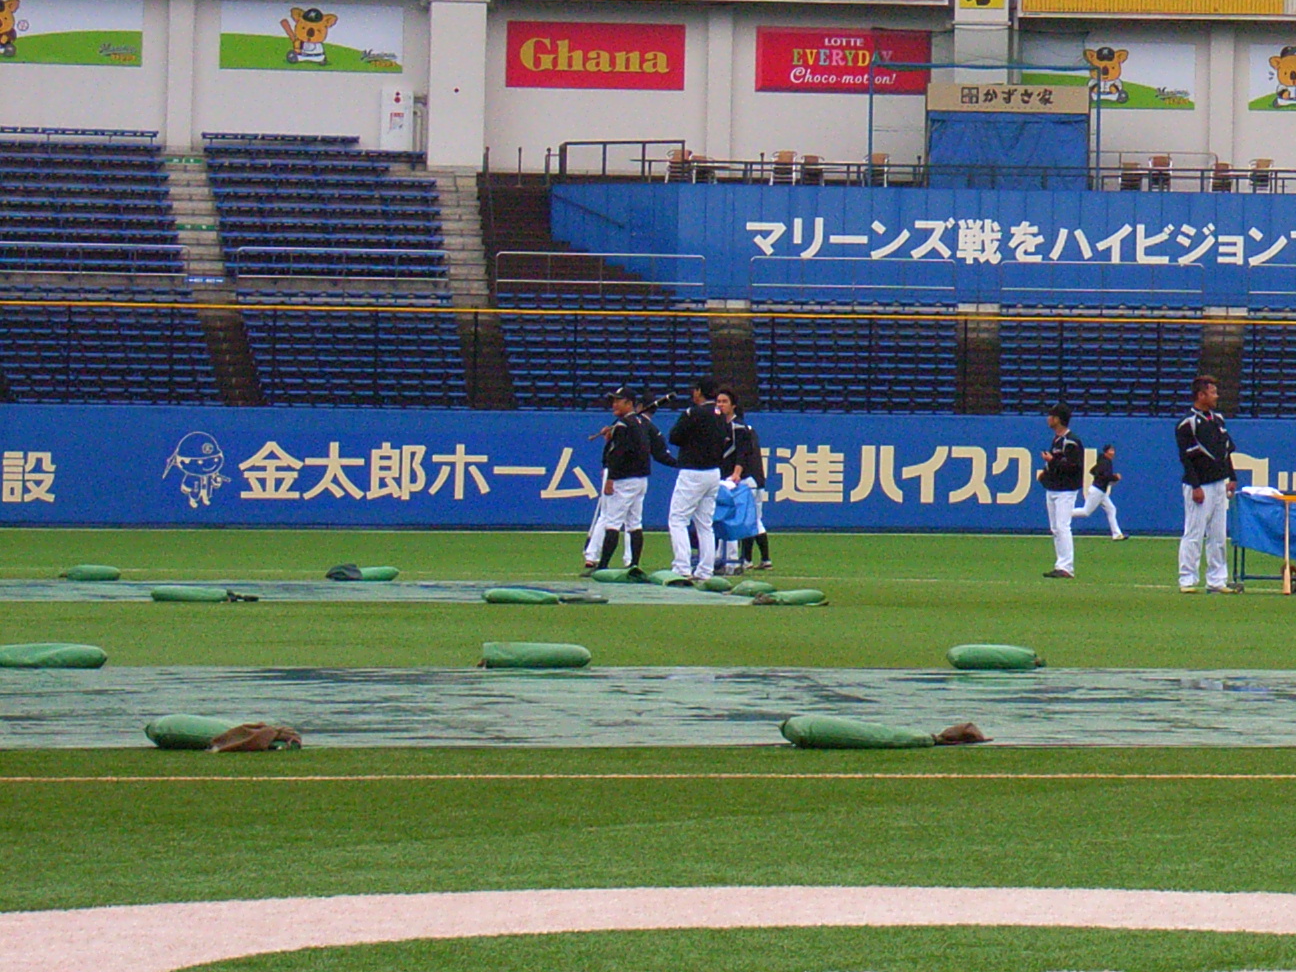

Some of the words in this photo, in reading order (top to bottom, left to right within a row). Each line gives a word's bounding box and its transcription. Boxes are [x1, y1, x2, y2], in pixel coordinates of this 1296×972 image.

[519, 37, 670, 74] Ghana
[792, 49, 893, 66] EVERYDAY
[824, 37, 864, 47] LOTTE
[2, 451, 55, 503] 設
[238, 441, 599, 501] 金太郎ホーム
